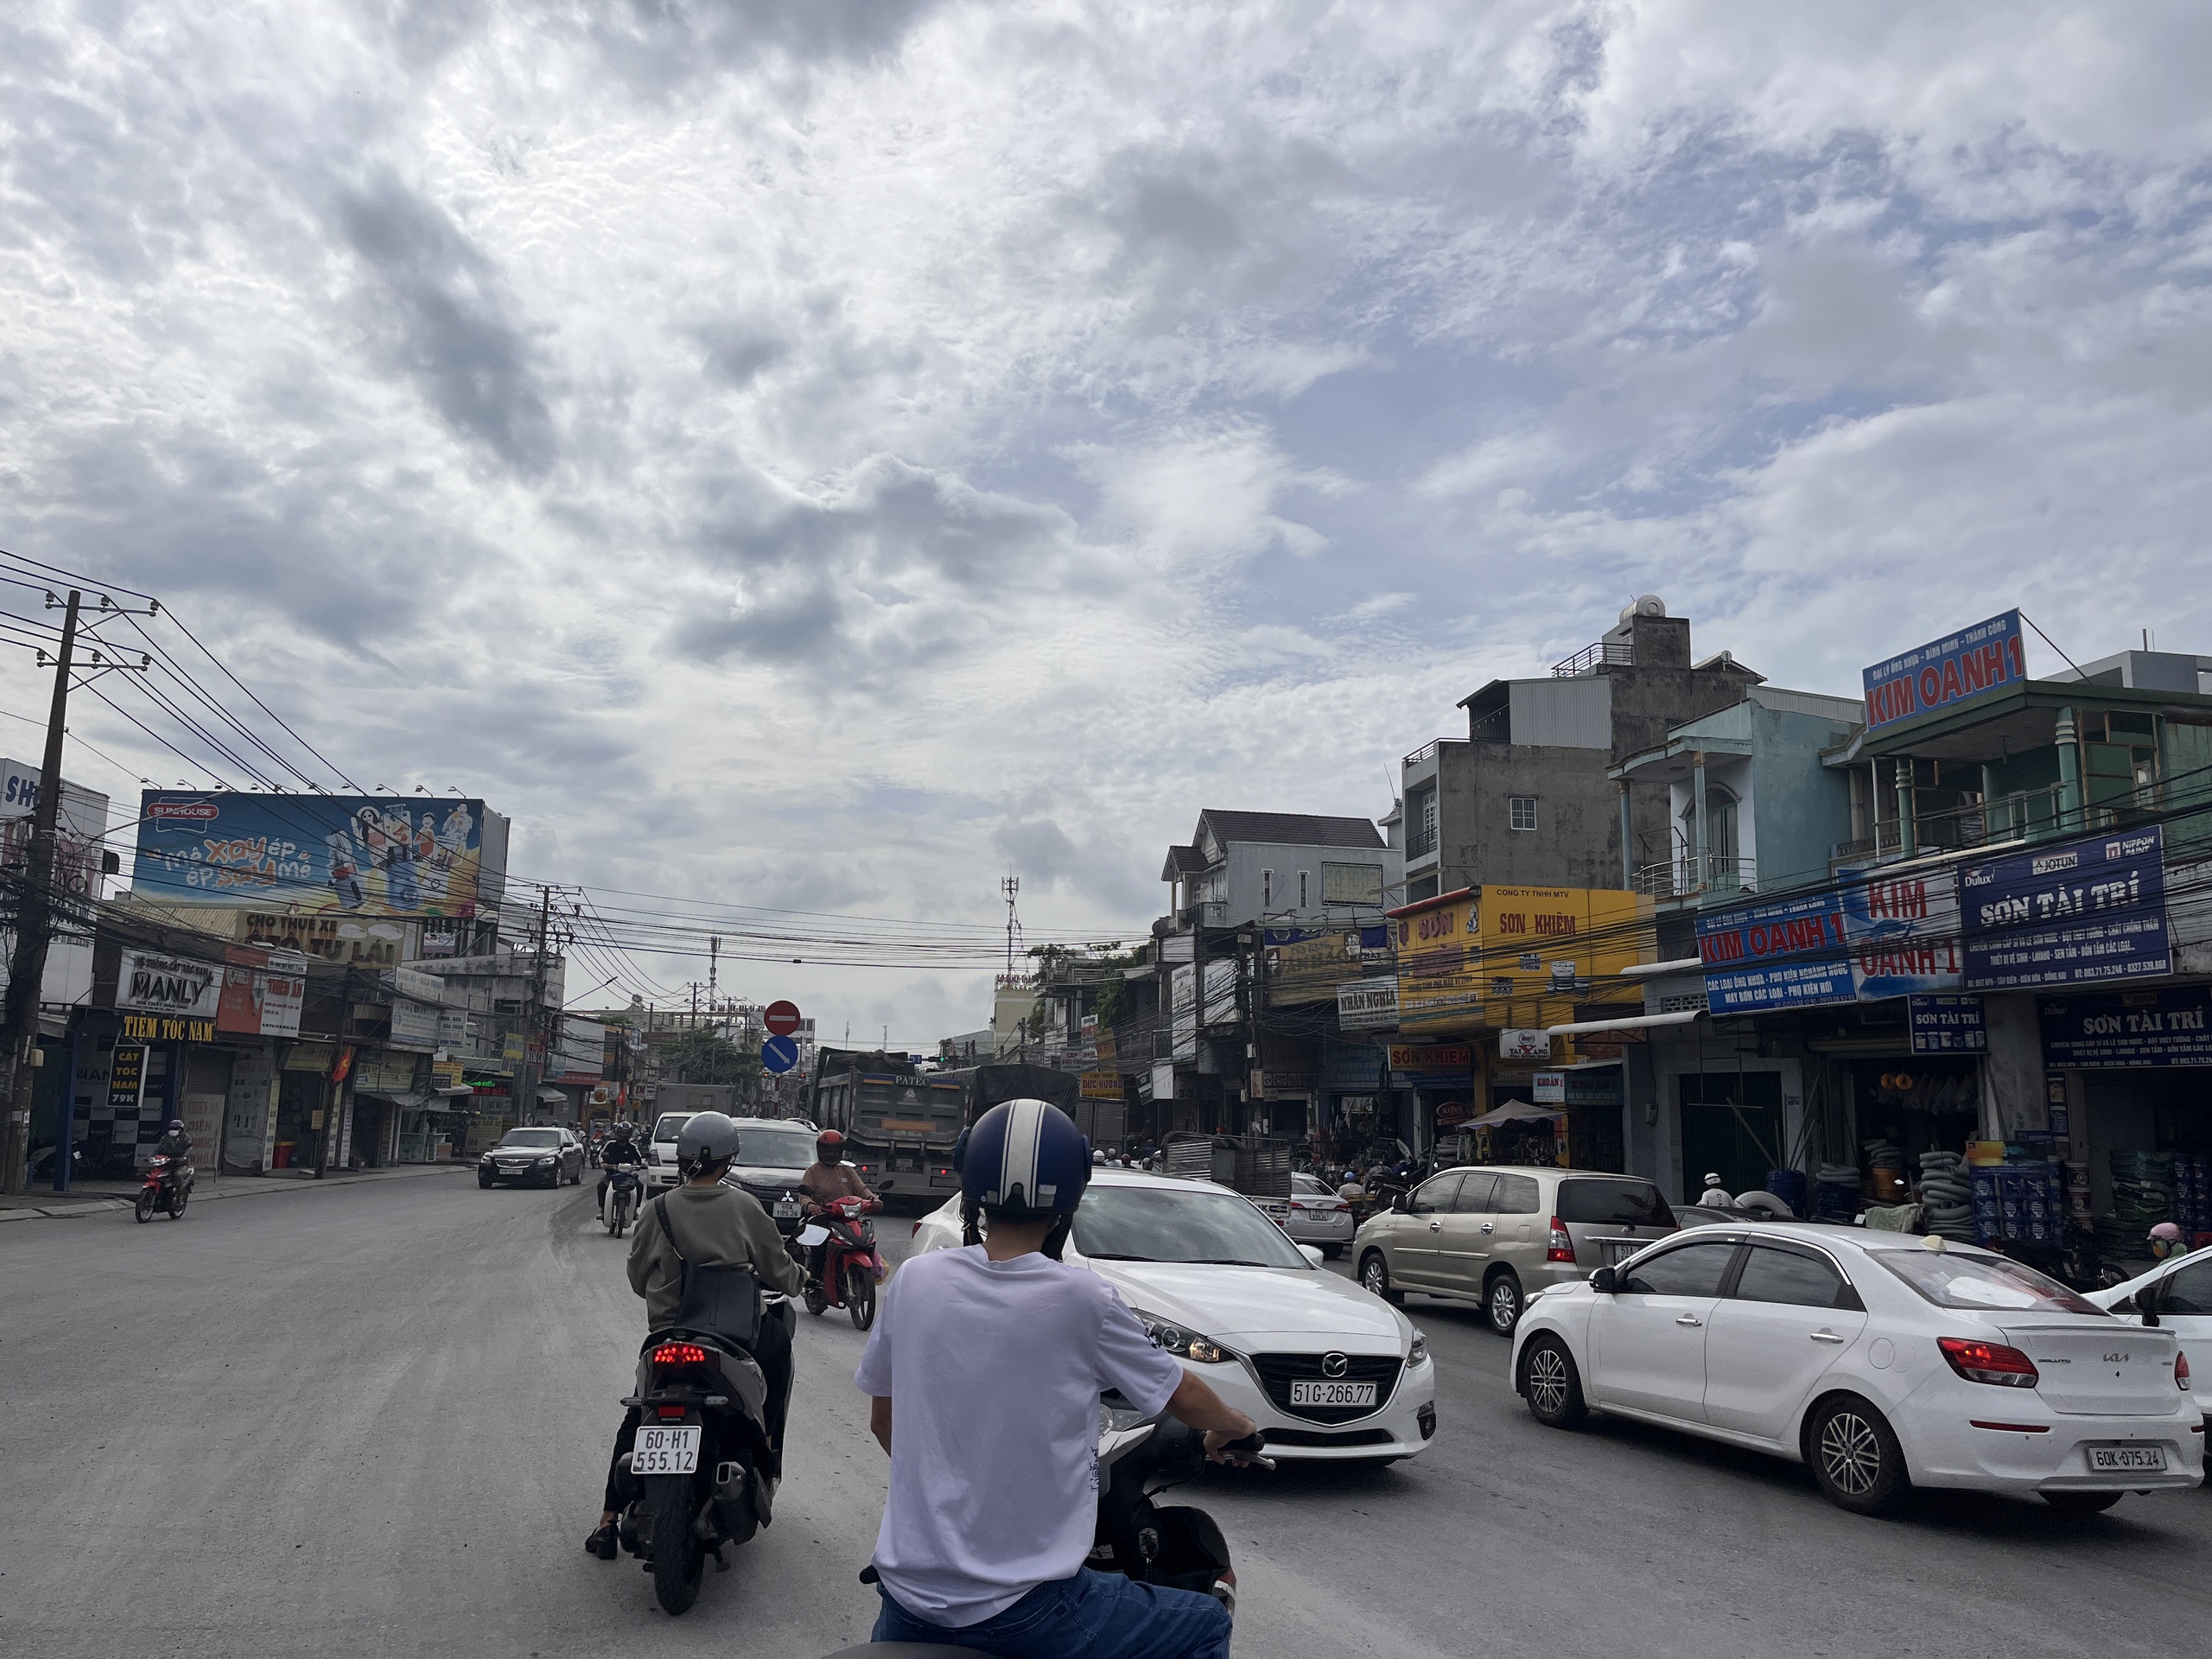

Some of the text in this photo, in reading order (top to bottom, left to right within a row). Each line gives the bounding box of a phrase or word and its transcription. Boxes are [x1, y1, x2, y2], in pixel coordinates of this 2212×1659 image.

[1884, 665, 1891, 676] LÝ
[1891, 659, 1903, 673] ỐNG
[1904, 653, 1919, 668] NHỰA
[1925, 646, 1941, 660] BÌNH
[1942, 638, 1959, 654] MINH
[1965, 626, 1986, 645] THÀNH
[1987, 619, 2006, 636] CÔNG
[1866, 633, 2024, 728] KIM OANH 1
[154, 806, 213, 817] SUNHOUSE
[204, 836, 267, 863] xay
[268, 837, 296, 861] ép
[2122, 836, 2155, 849] NIPPON
[186, 867, 214, 887] ép
[277, 861, 312, 878] mê
[2044, 856, 2075, 871] JOTUN
[1965, 875, 1992, 887] Dulux
[1868, 880, 1927, 918] KIM
[1980, 870, 2139, 927] SƠN TÀI TRÍ
[246, 913, 338, 932] CHO THUÊ XE
[1418, 911, 1453, 939] SƠN
[1500, 912, 1576, 935] SƠN KHIÊM
[1700, 911, 1846, 964] KIM OANH 1
[352, 938, 395, 965] LÁI
[1859, 937, 1960, 976] OANH 1
[2055, 949, 2065, 959] SEN
[2106, 940, 2117, 954] CÁC
[146, 957, 168, 969] THỐNG
[195, 967, 209, 976] NAM
[130, 971, 206, 1005] MANLY
[1707, 977, 1719, 991] CÁC
[1720, 978, 1732, 991] LOẠI
[1733, 975, 1746, 988] ỐNG
[1747, 974, 1765, 986] NHỰA
[1770, 972, 1783, 984] PHỤ
[1783, 968, 1798, 982] KIỆN
[1341, 988, 1396, 1011] NHÂN NGHĨA
[1738, 990, 1754, 1002] BƠM
[1754, 988, 1767, 1001] CÁC
[1768, 987, 1783, 1000] LOẠI
[1788, 986, 1802, 998] PHỤ
[1802, 983, 1819, 995] KIỆN
[1820, 980, 1834, 993] HƠI
[124, 1011, 213, 1041] TIỆM TÓC NAM
[1916, 1010, 1980, 1025] SƠN TÀI TRÍ
[2083, 1005, 2204, 1035] SƠN TÀI TRÍ
[112, 1081, 138, 1090] NAM
[895, 1076, 930, 1086] PATEC
[111, 1094, 135, 1103] 79K
[2102, 1352, 2130, 1363] KIA
[1294, 1383, 1374, 1403] 51G-266.77
[645, 1431, 689, 1449] 60-H1
[637, 1451, 694, 1471] 555.12
[2096, 1451, 2159, 1466] 60K-075.24
